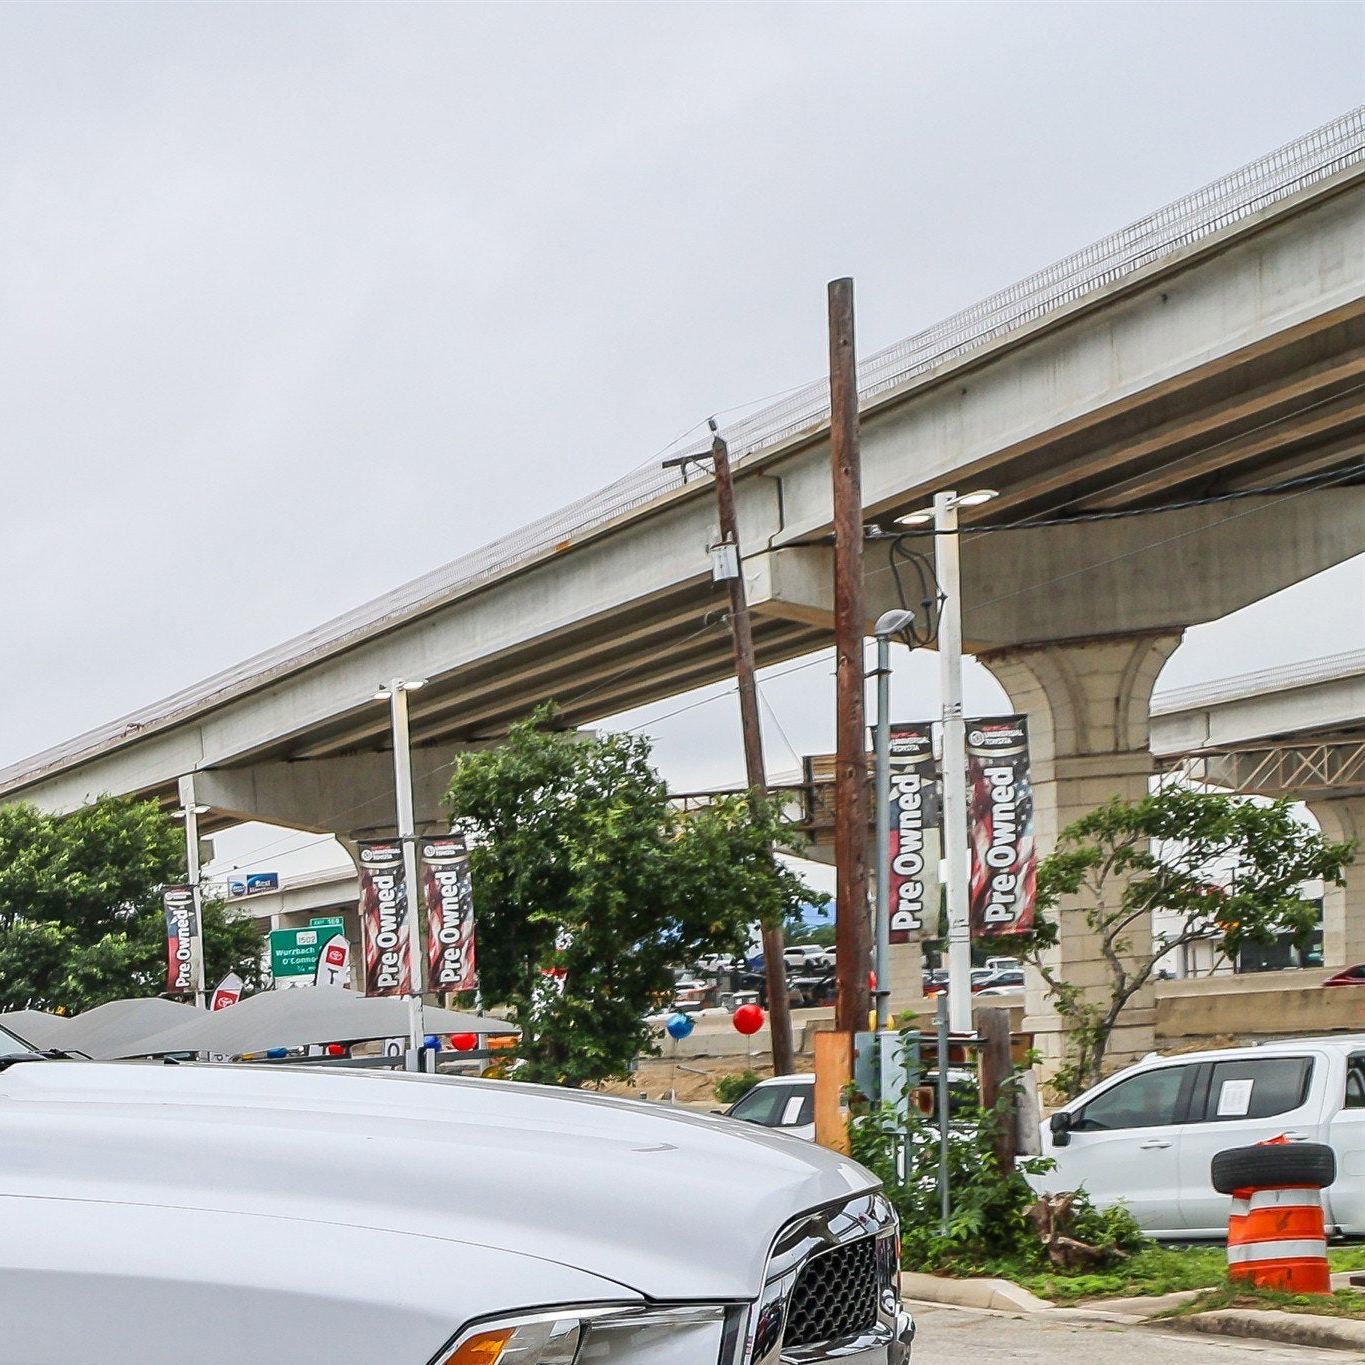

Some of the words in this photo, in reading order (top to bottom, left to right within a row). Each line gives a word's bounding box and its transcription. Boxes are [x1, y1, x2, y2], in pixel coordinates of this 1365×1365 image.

[891, 774, 923, 876] Owned
[984, 766, 1016, 868] Owned
[373, 875, 398, 948] Owned
[435, 871, 460, 943] Owned
[891, 880, 923, 931] Pre
[984, 872, 1016, 923] Pre
[173, 910, 191, 960] Owned
[276, 947, 315, 956] Wurzbach
[175, 961, 191, 987] Pre
[378, 952, 399, 987] Pre
[440, 947, 461, 983] Pre
